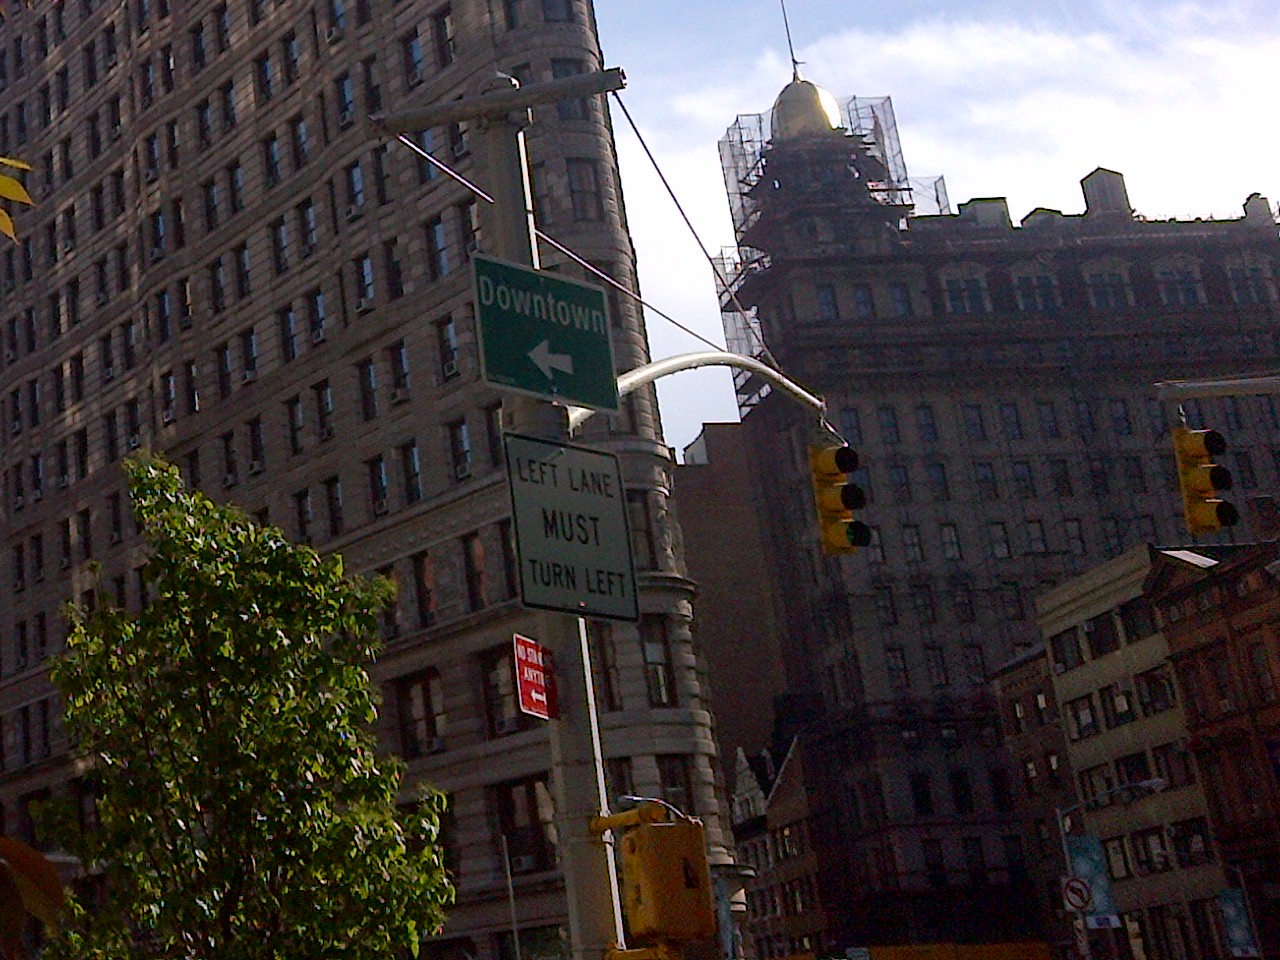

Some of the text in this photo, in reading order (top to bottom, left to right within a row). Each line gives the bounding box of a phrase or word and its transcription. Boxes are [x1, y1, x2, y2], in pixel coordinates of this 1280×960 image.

[479, 275, 605, 335] Downtown
[516, 457, 614, 499] LEFT LANE
[542, 507, 600, 546] MUST
[529, 559, 626, 599] TURN LEFT
